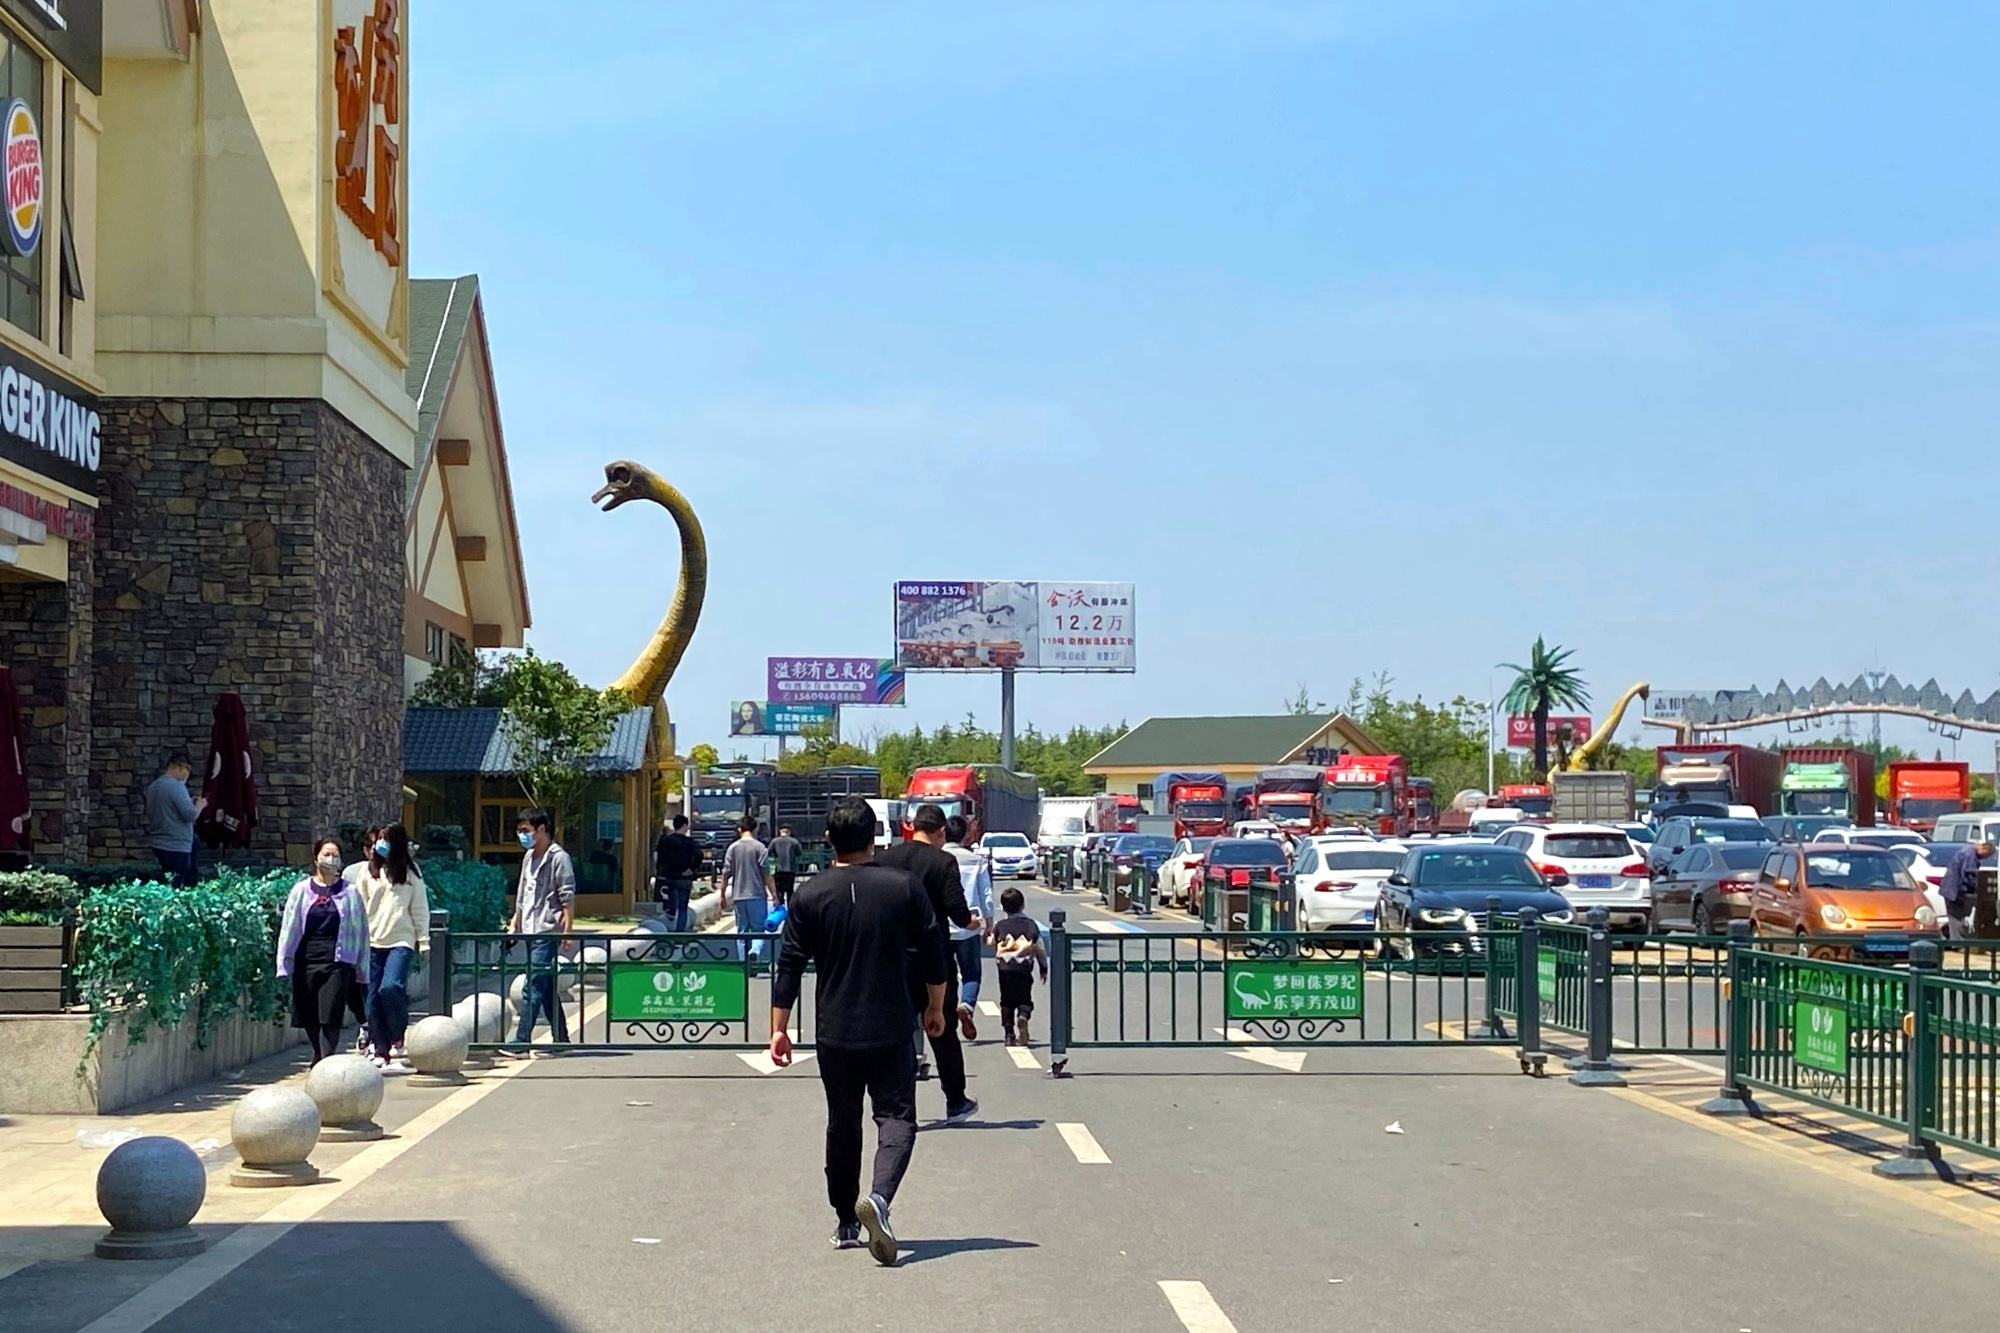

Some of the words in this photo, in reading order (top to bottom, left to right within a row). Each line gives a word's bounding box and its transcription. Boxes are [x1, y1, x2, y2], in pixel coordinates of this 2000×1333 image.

[7, 133, 39, 170] BURGER
[7, 165, 41, 208] KING
[0, 364, 46, 448] GER
[50, 388, 101, 472] KING
[901, 585, 919, 595] 400
[921, 585, 939, 596] 882
[942, 585, 966, 596] 1376
[1055, 614, 1124, 632] 12.2万
[1273, 974, 1357, 990] 梦回侏罗纪
[1273, 994, 1356, 1010] 乐享芳茂山
